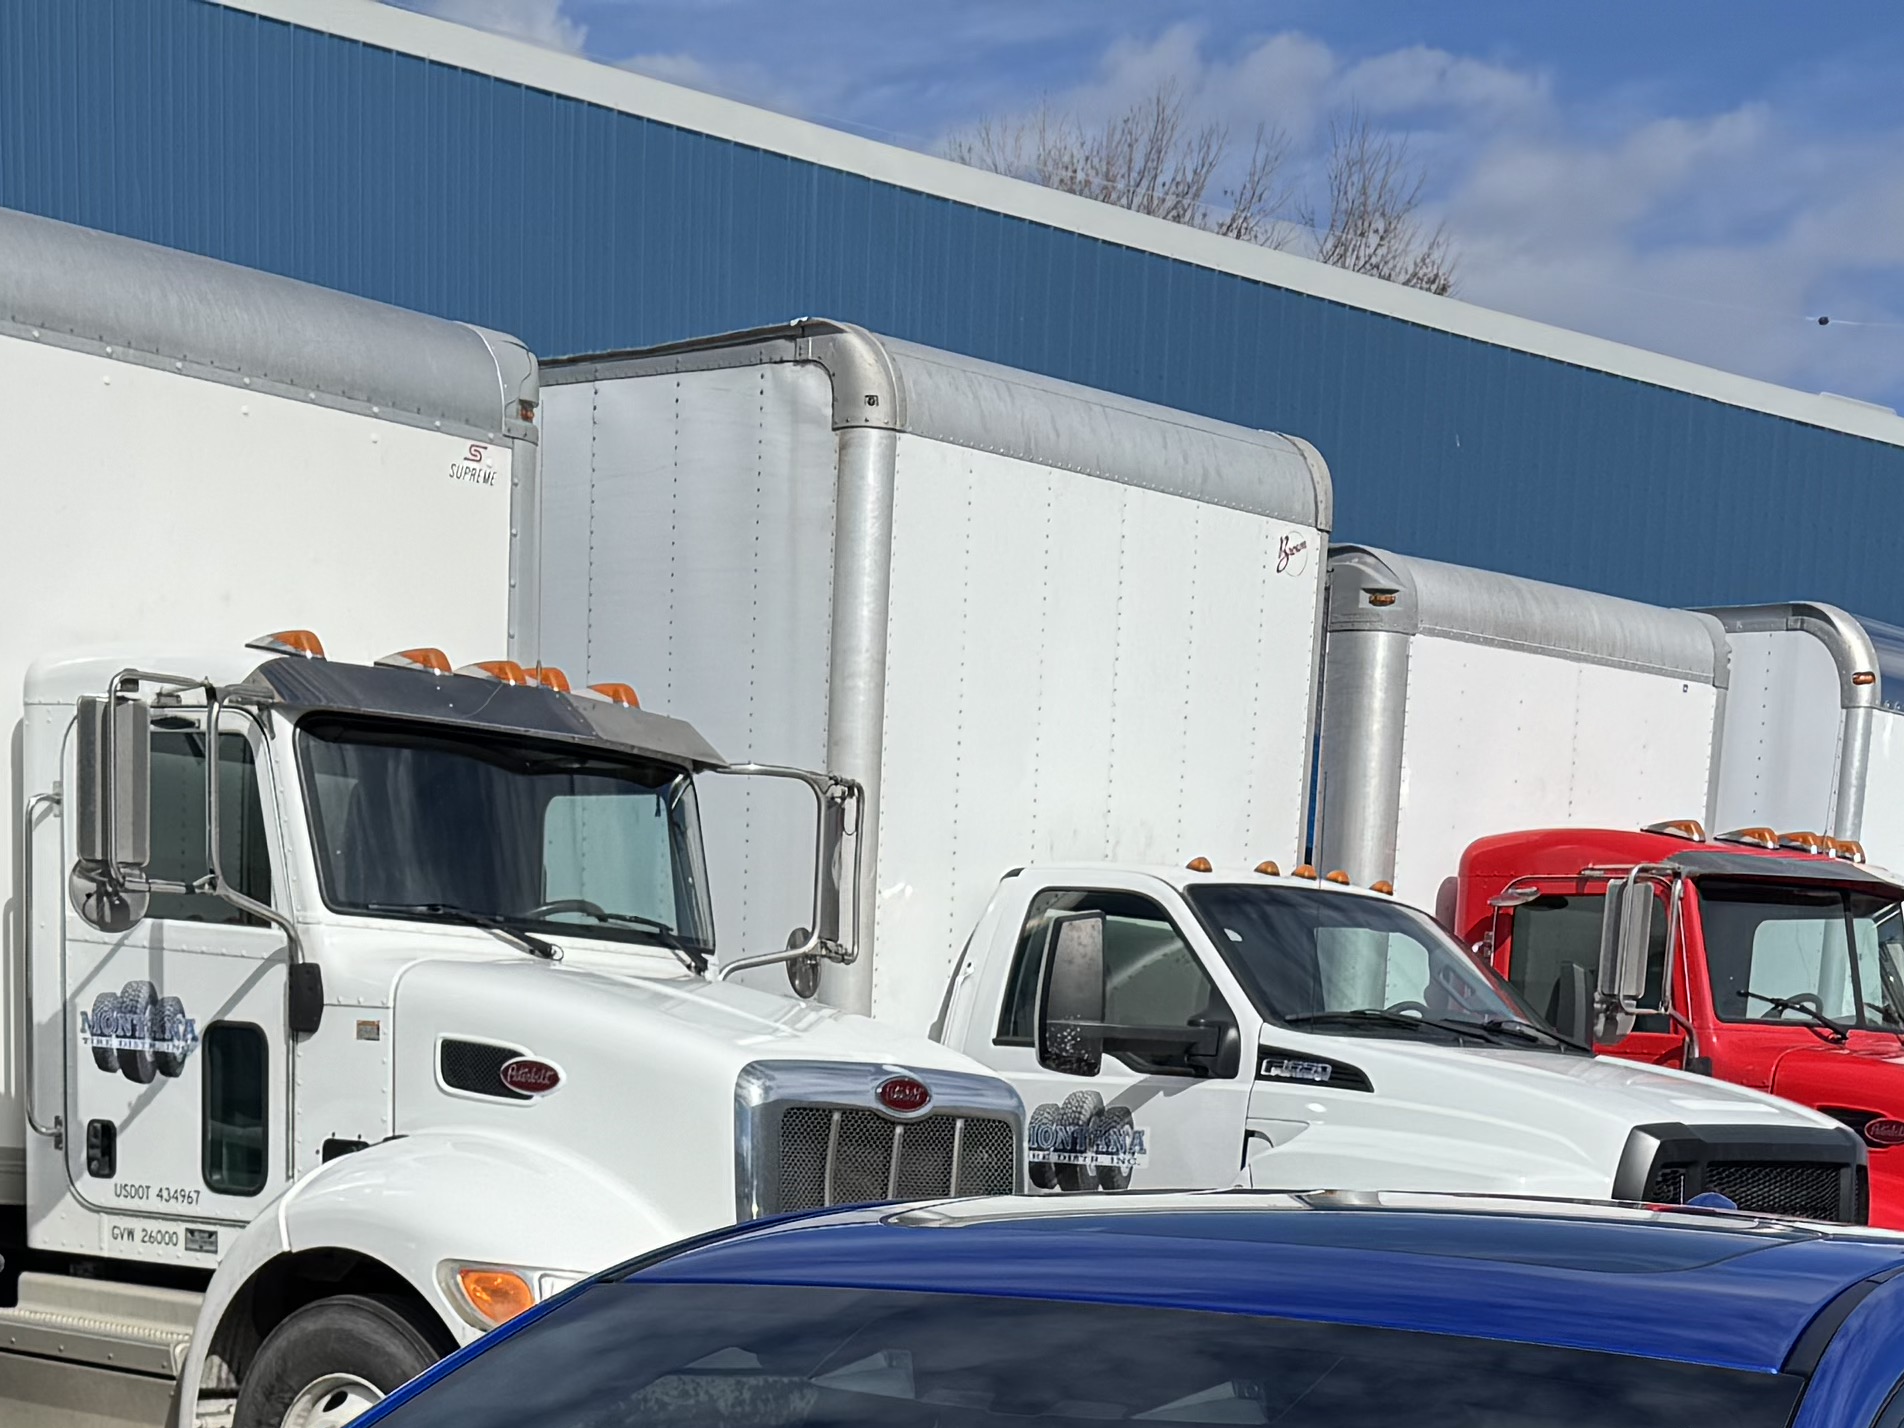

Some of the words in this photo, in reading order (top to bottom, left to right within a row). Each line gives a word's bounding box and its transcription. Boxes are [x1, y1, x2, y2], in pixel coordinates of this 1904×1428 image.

[449, 463, 496, 486] SUPREME
[114, 1183, 151, 1200] USDOT
[156, 1187, 201, 1206] 434967
[112, 1225, 135, 1242] GVW
[141, 1228, 179, 1247] 26000
